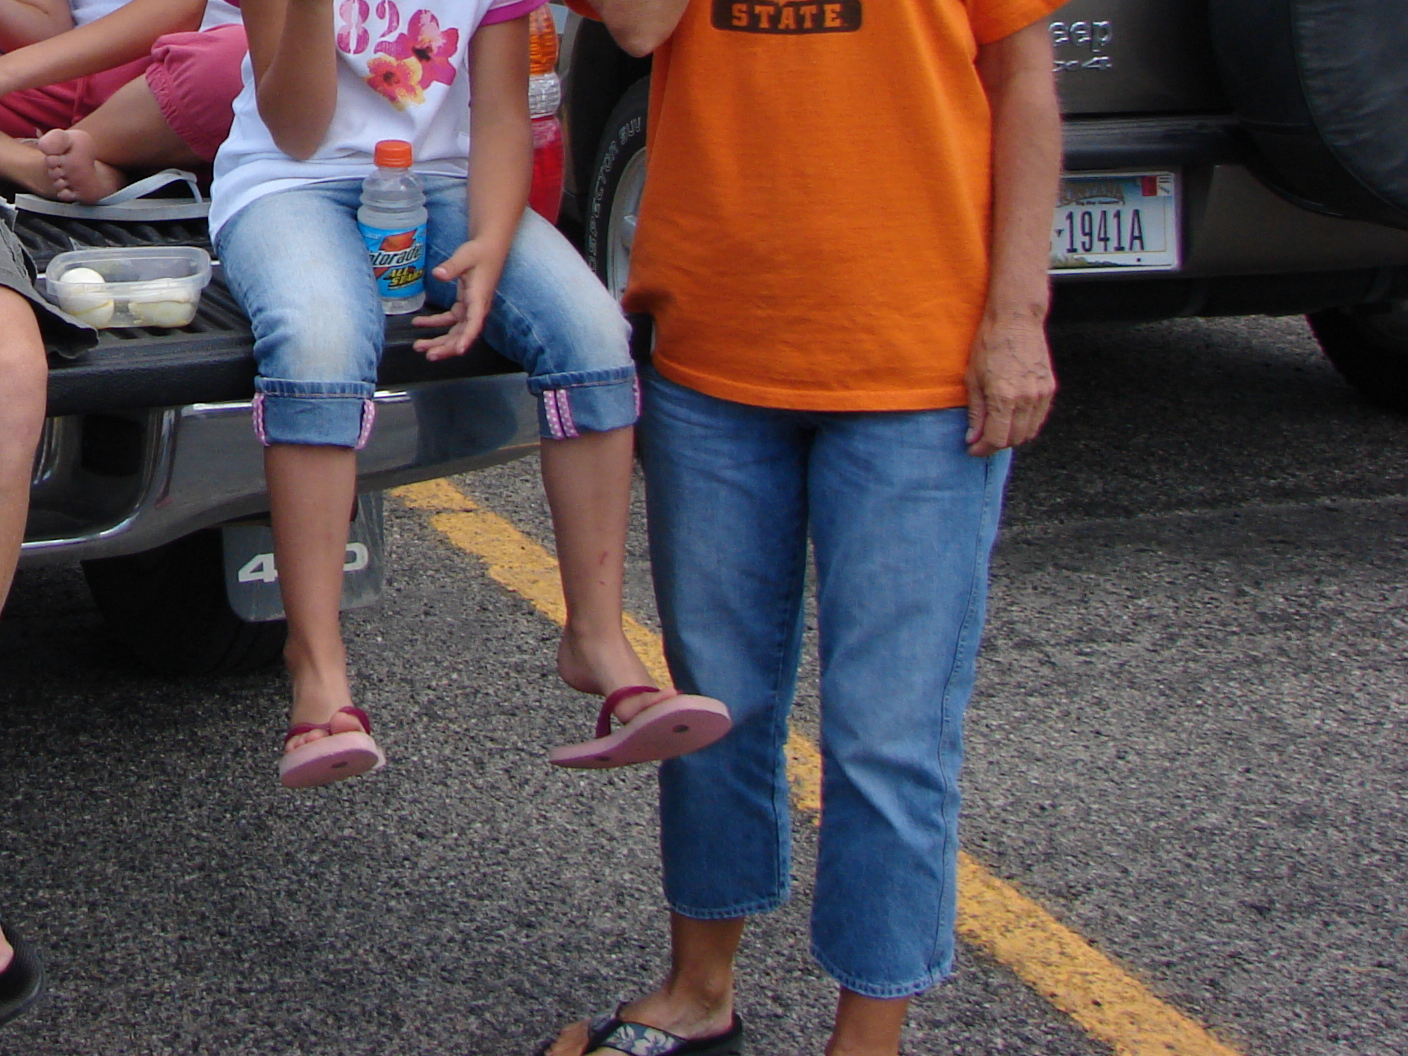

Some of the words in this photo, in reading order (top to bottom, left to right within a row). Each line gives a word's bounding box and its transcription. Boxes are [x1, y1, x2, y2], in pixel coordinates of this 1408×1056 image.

[730, 2, 844, 30] STATE
[1048, 20, 1113, 53] eep
[1051, 55, 1113, 73] x4
[1065, 208, 1145, 253] 1941A
